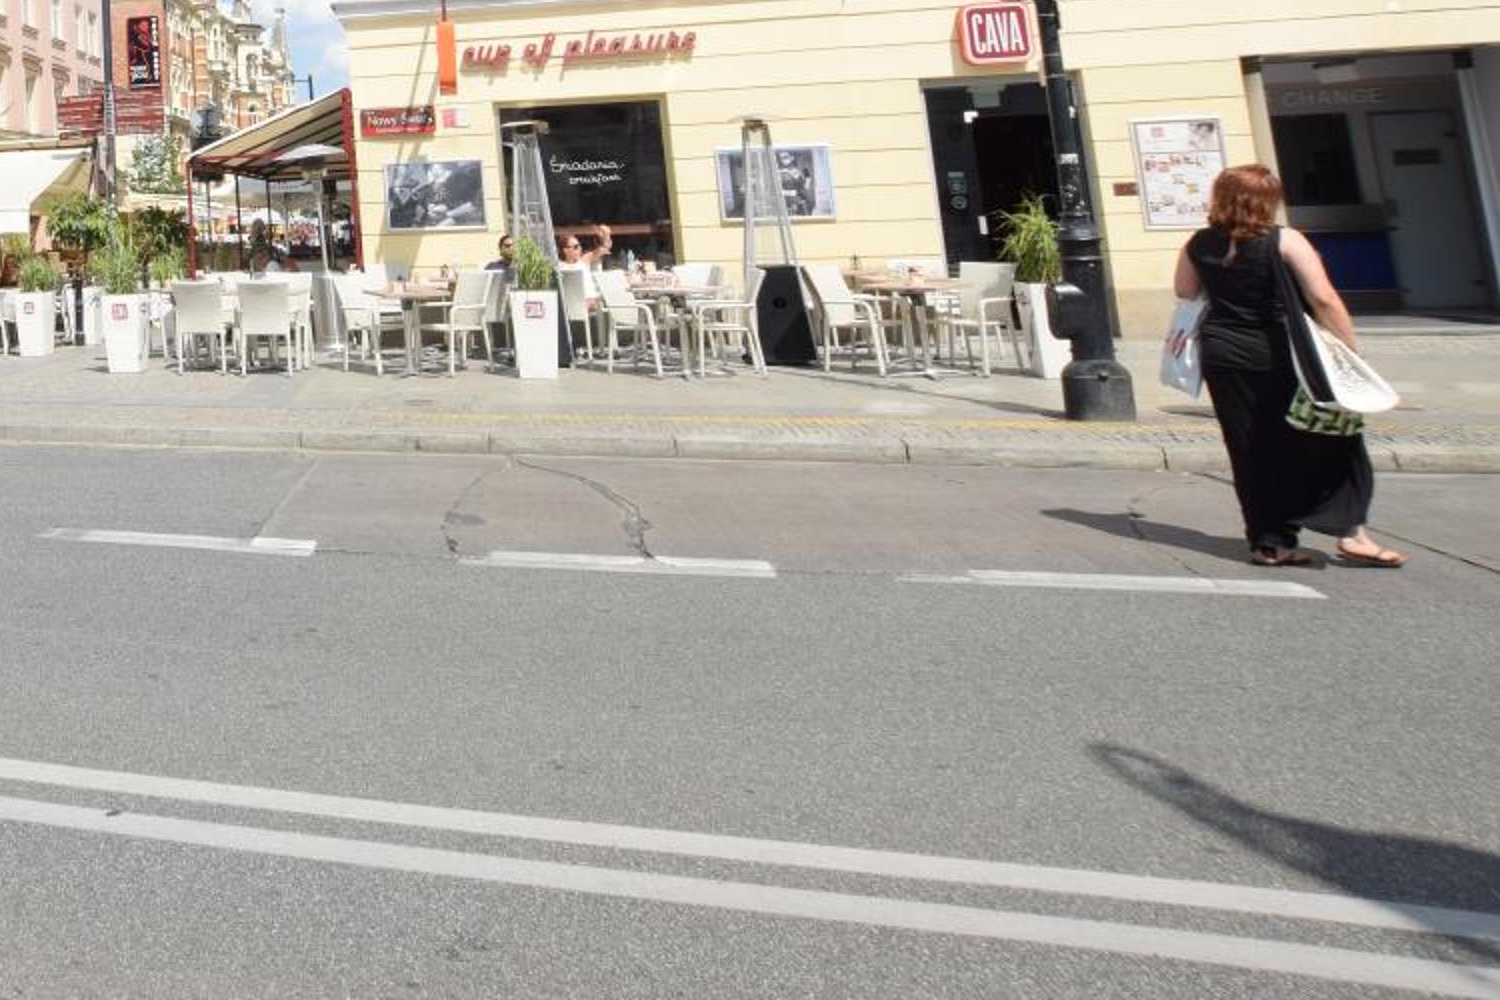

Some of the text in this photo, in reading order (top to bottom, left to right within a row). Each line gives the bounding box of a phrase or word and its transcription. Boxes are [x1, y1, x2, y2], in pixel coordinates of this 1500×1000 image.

[461, 30, 696, 69] cup of pleasure
[970, 10, 1025, 55] CAVA
[1283, 86, 1382, 107] CHANGE
